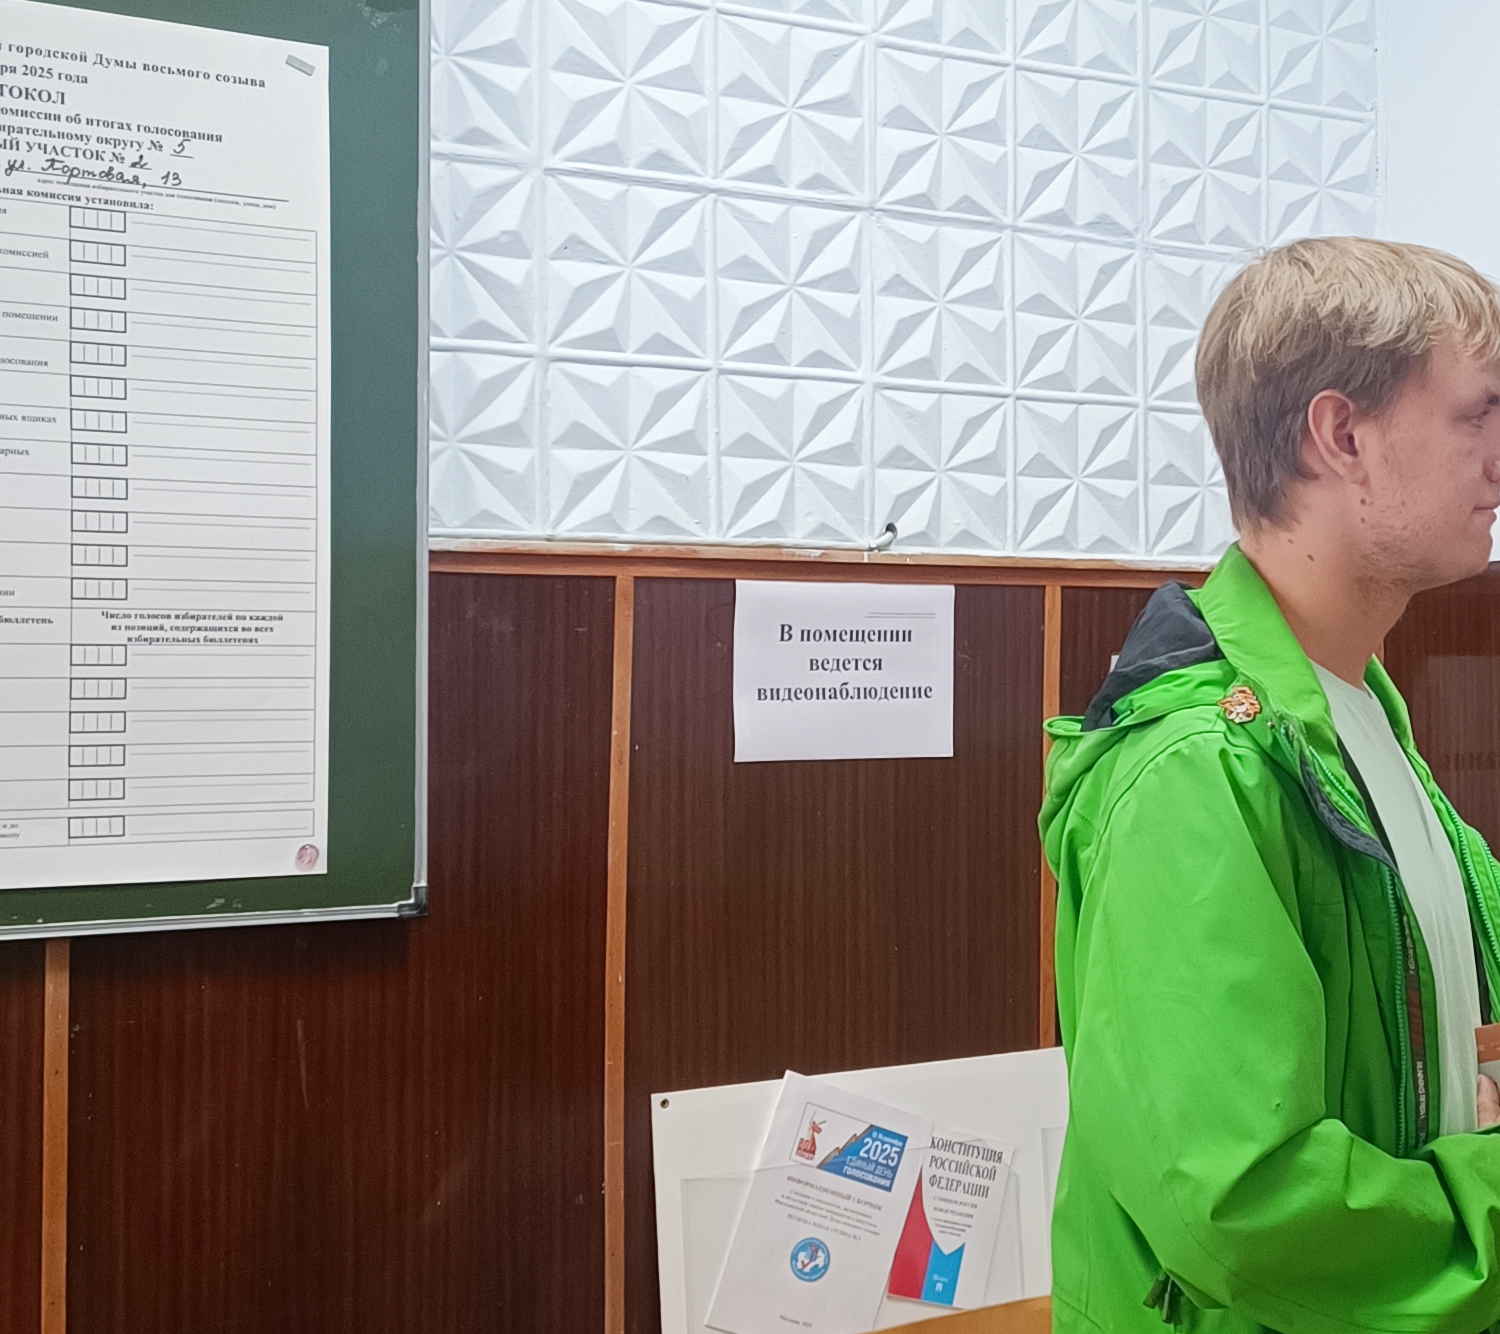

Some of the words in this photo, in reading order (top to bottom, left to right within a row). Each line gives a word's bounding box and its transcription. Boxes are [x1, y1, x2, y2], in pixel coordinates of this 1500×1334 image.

[8, 43, 87, 63] городской
[92, 53, 137, 69] Думы
[142, 62, 211, 80] восьмого
[215, 73, 266, 88] созыва
[21, 64, 54, 79] 2025
[58, 71, 88, 85] года
[65, 113, 82, 125] об
[85, 117, 133, 132] итогах
[136, 124, 223, 143] голосования
[25, 141, 106, 162] УЧАСТОК
[96, 135, 144, 152] округу
[173, 138, 192, 154] 5
[160, 170, 182, 187] 13
[27, 189, 82, 203] комиссия
[85, 196, 154, 211] установила:
[2, 311, 59, 322] помещении
[102, 611, 132, 620] Число
[135, 612, 172, 620] голосов
[174, 612, 233, 623] избирателей
[249, 614, 284, 622] каждой
[778, 623, 793, 643] В
[800, 627, 913, 645] помещении
[808, 657, 884, 673] ведется
[756, 681, 934, 704] видеонаблюдение
[859, 1137, 901, 1167] 2025
[929, 1136, 1004, 1165] КОНСТИТУЦИЯ
[929, 1155, 997, 1182] РОССИЙСКОЙ
[929, 1174, 990, 1199] ФЕДЕРАЦИИ
